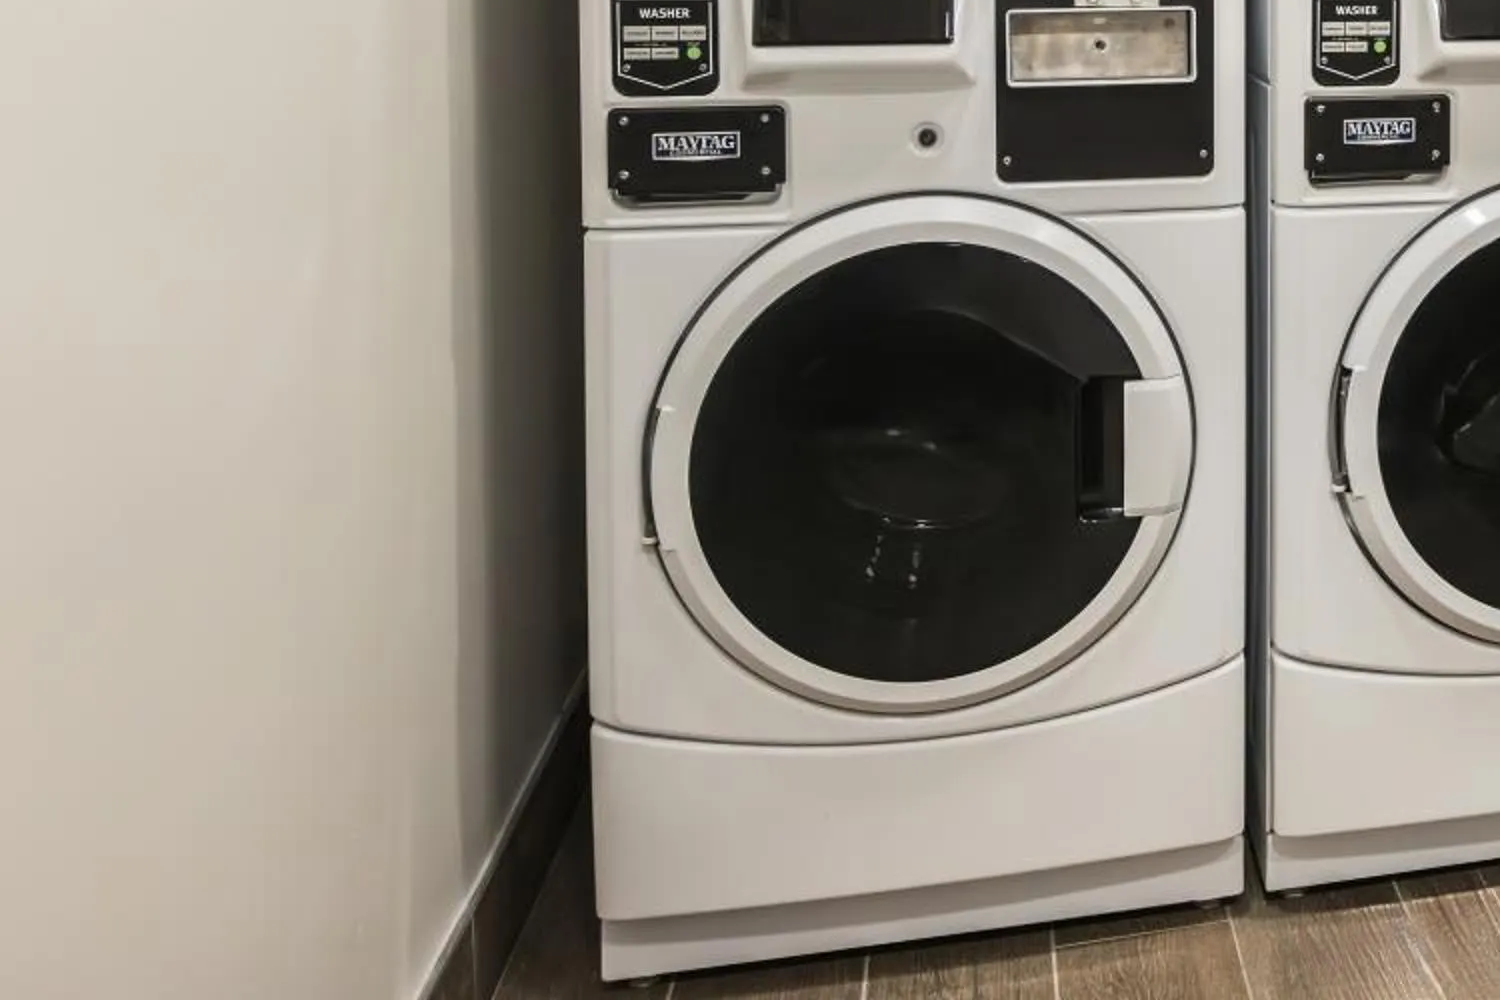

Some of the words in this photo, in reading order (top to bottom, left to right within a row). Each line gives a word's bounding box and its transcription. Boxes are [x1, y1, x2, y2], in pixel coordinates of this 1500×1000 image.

[639, 7, 691, 19] WASHER
[1335, 5, 1378, 16] WASHER
[1347, 120, 1411, 136] MAYTAG
[657, 134, 735, 151] MAYTAG
